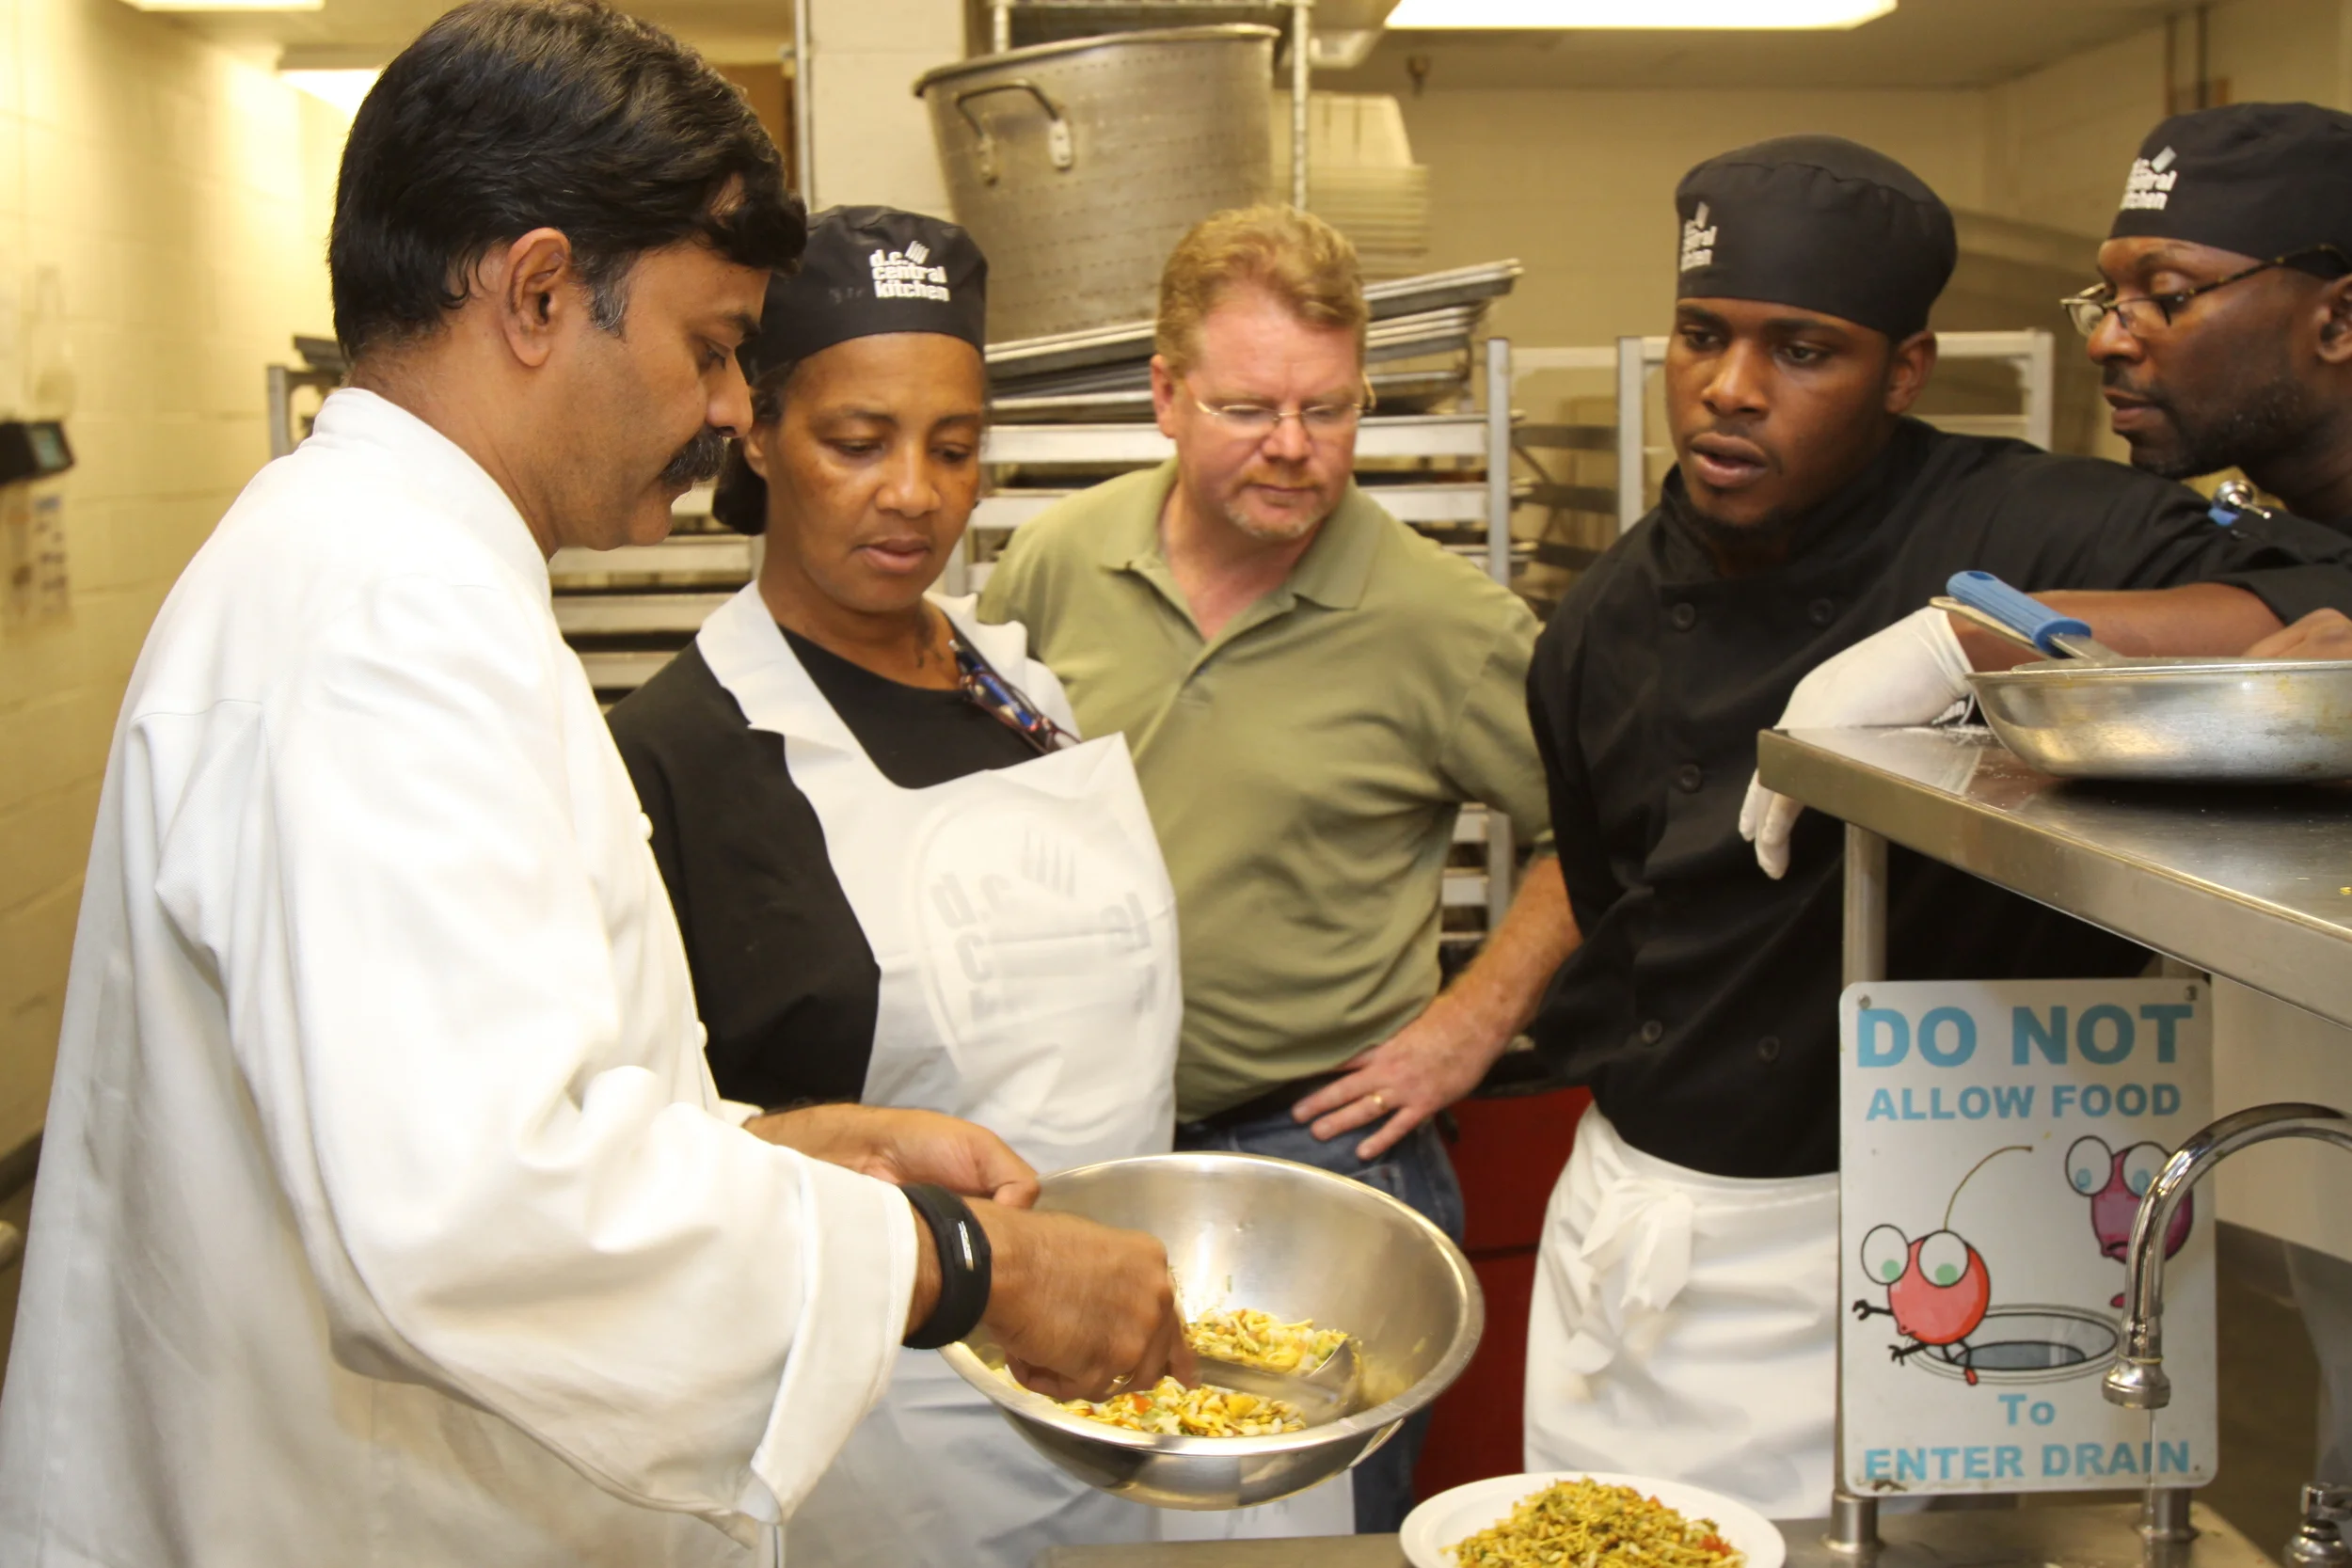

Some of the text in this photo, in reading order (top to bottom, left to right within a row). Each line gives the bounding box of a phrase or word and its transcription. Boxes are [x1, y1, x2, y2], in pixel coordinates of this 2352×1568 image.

[872, 262, 947, 283] central
[874, 279, 950, 302] kitchen
[1857, 1004, 2193, 1069] DO NOT
[1866, 1084, 2182, 1120] ALLOW FOOD
[1998, 1394, 2056, 1426] To
[1865, 1441, 2189, 1481] ENTER DRAIN
